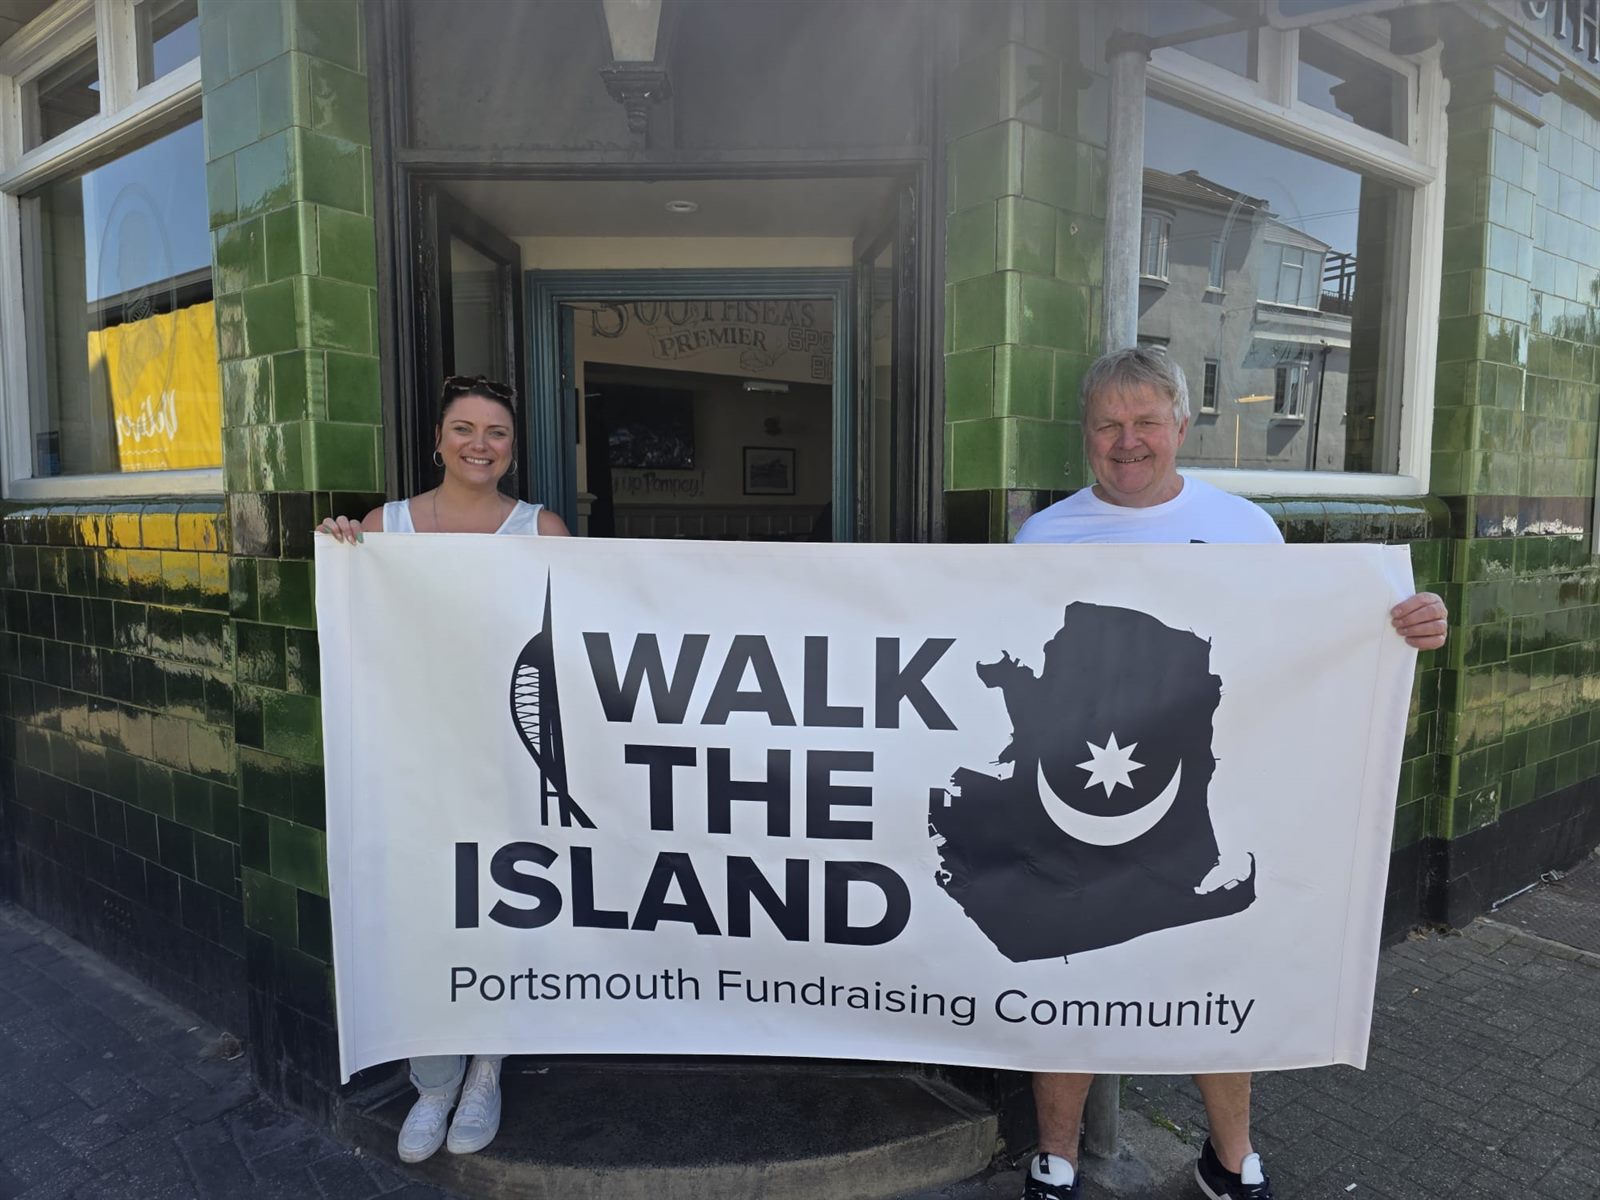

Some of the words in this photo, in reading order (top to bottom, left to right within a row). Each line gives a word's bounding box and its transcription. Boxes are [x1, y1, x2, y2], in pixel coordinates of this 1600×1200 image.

[658, 327, 768, 358] PREMIER
[583, 632, 958, 730] WALK
[625, 744, 873, 840] THE
[455, 842, 911, 946] ISLAND
[451, 967, 699, 1002] Portsmouth
[719, 970, 975, 1026] Fundraising
[995, 990, 1255, 1034] Community
